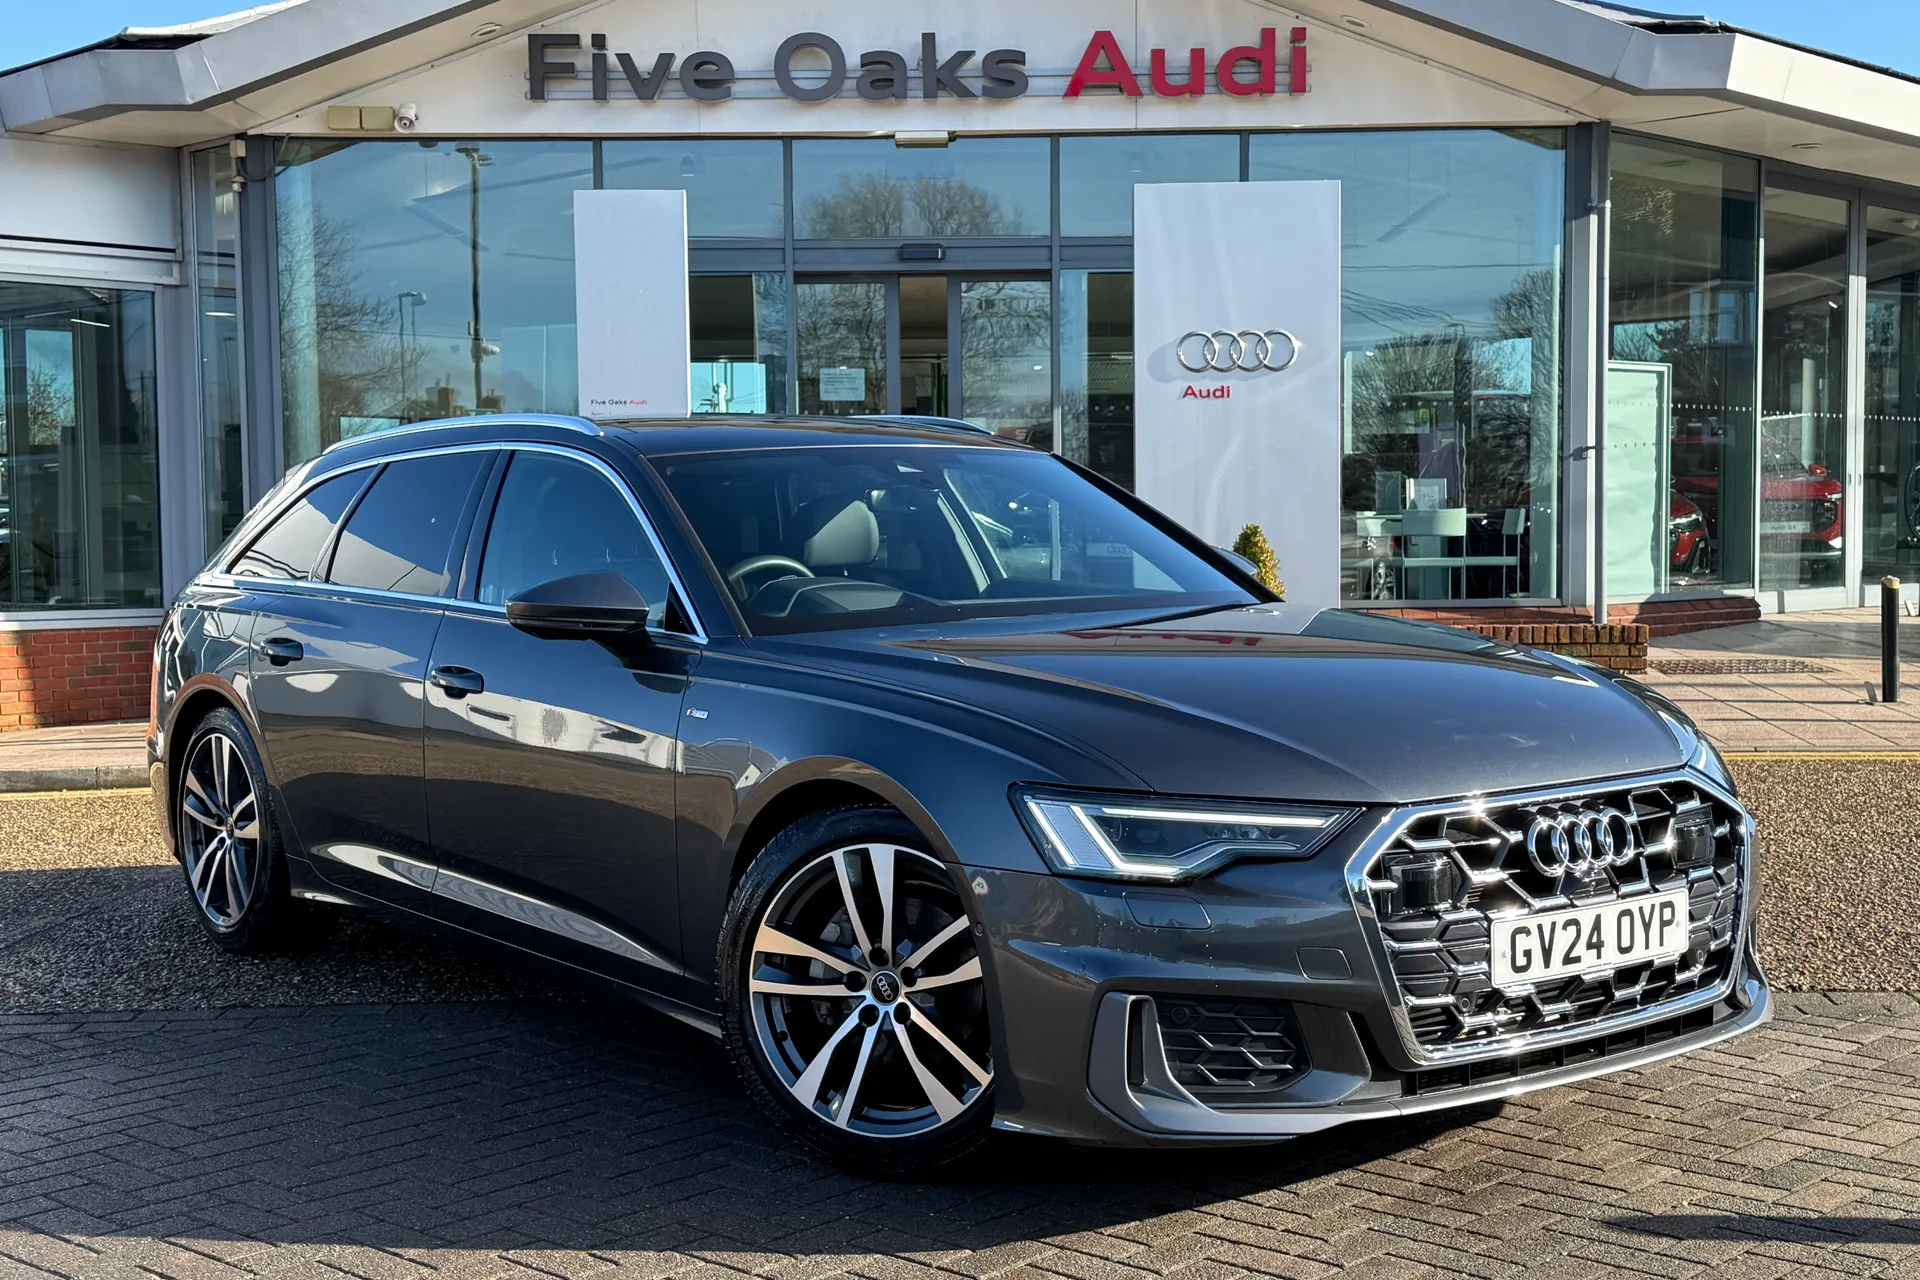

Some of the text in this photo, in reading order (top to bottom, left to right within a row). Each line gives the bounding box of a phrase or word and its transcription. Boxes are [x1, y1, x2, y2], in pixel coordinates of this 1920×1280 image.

[528, 27, 1306, 103] Five Oaks Audi
[1182, 384, 1231, 399] Audi
[1510, 900, 1676, 974] GV24 OYP
